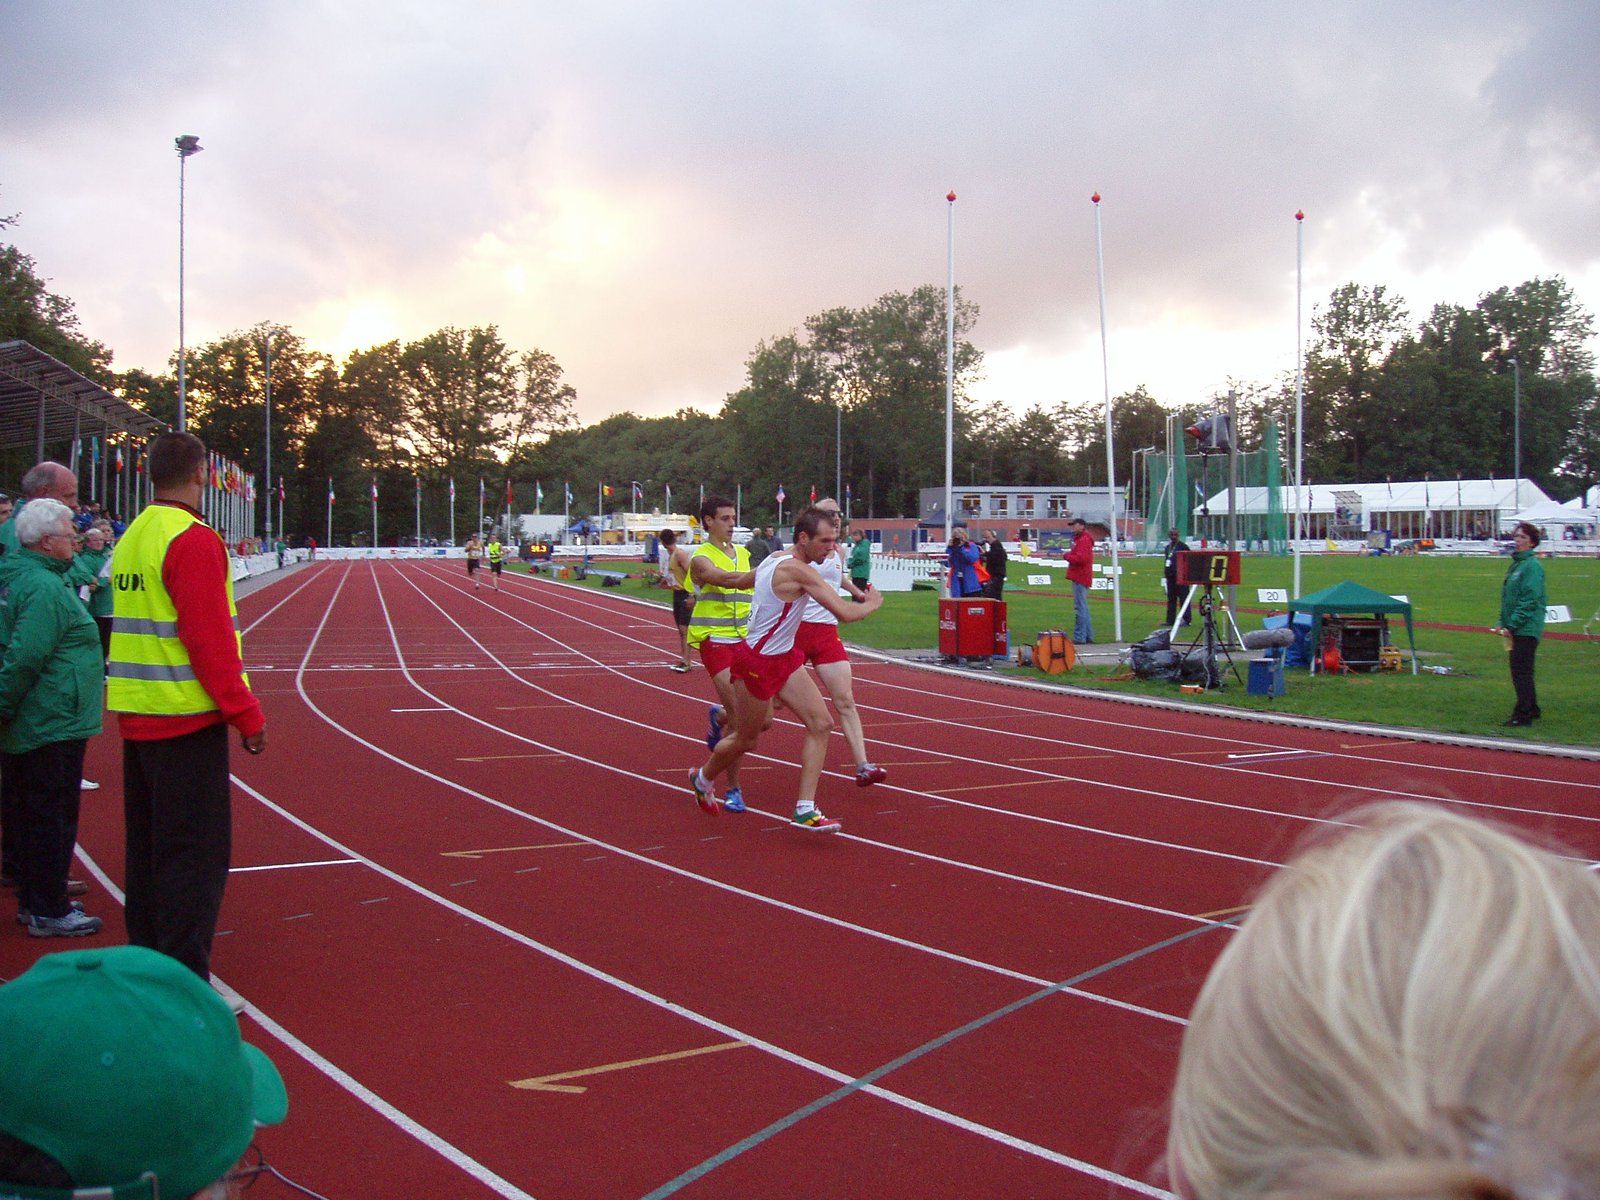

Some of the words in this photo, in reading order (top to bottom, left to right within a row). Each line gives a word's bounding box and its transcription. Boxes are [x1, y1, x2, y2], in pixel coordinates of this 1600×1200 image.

[1209, 556, 1228, 581] 0
[1096, 580, 1107, 588] 30
[1266, 591, 1279, 601] 20
